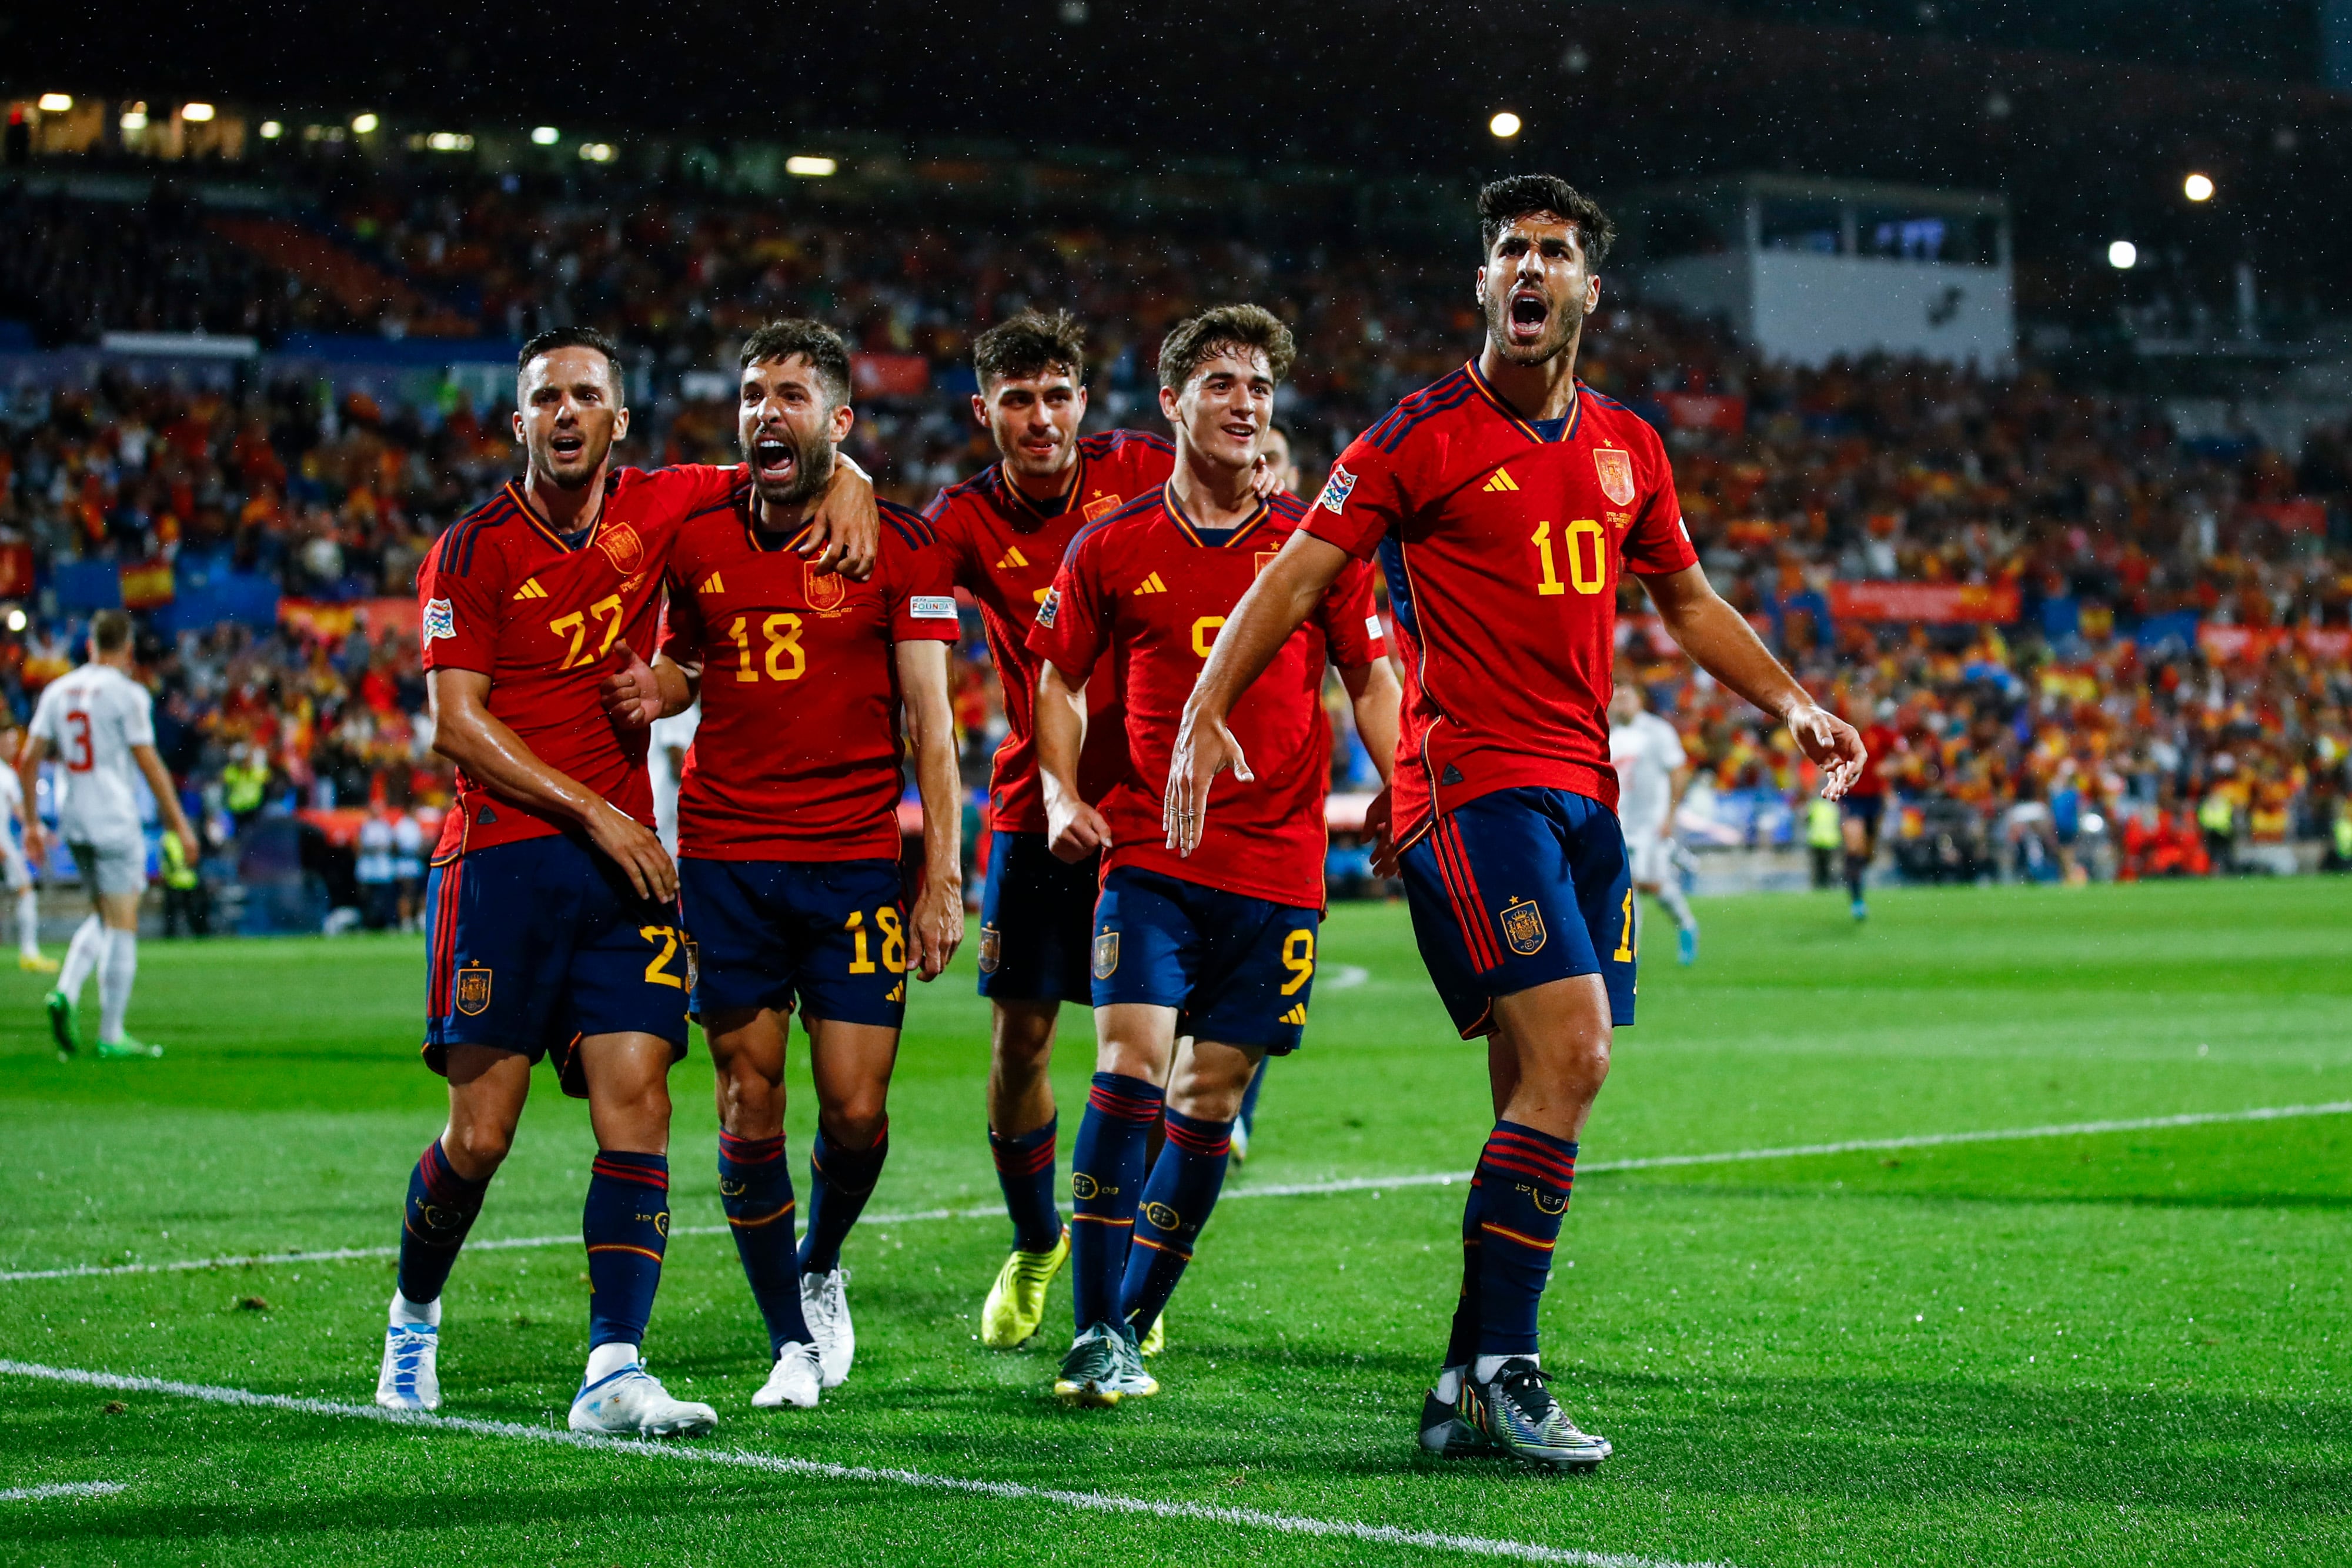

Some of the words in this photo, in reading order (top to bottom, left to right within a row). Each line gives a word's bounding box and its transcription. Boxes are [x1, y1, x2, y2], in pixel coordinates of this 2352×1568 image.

[1531, 520, 1605, 596] 10
[550, 594, 626, 670] 22
[728, 613, 806, 682] 18
[66, 711, 94, 774] 3
[844, 906, 907, 975] 18
[1280, 928, 1315, 997] 9
[1101, 1186, 1119, 1195] 09
[1543, 1195, 1562, 1205] EF
